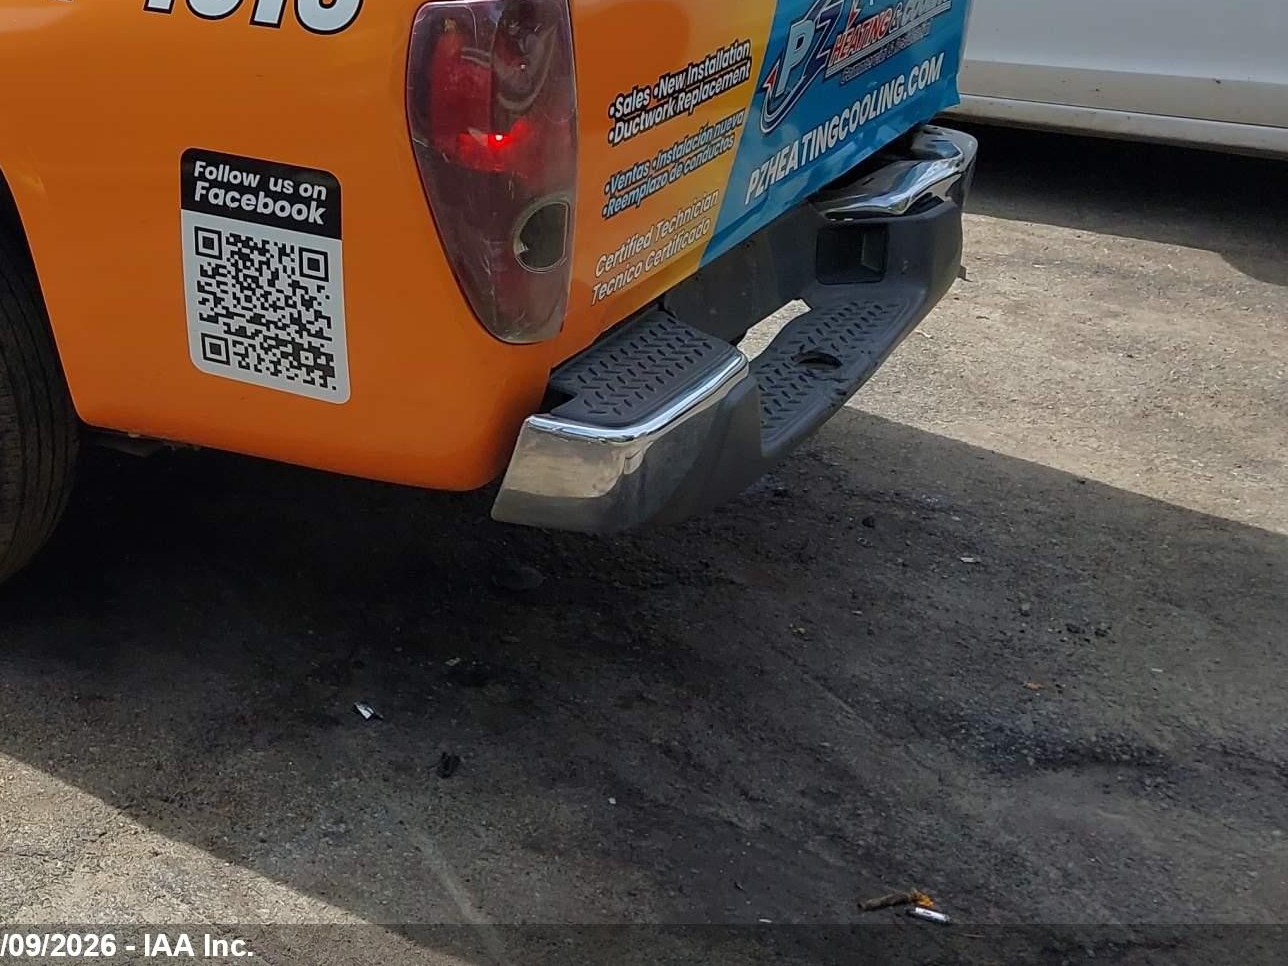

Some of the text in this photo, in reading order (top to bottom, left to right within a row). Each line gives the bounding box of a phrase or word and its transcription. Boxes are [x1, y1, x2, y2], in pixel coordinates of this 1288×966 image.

[615, 40, 751, 118] Sales New Installation
[828, 8, 893, 68] HEATING
[614, 60, 752, 144] Ductwork Replacement
[745, 52, 945, 205] PZHEATINGCOOLING.COM
[193, 159, 328, 202] Follow us on
[606, 134, 735, 218] Reemplazo de conductos
[609, 111, 745, 196] Ventas Instalación nueva
[193, 180, 328, 226] Facebook
[595, 190, 720, 278] Certified Technician
[591, 219, 711, 307] Tecnico Certificado
